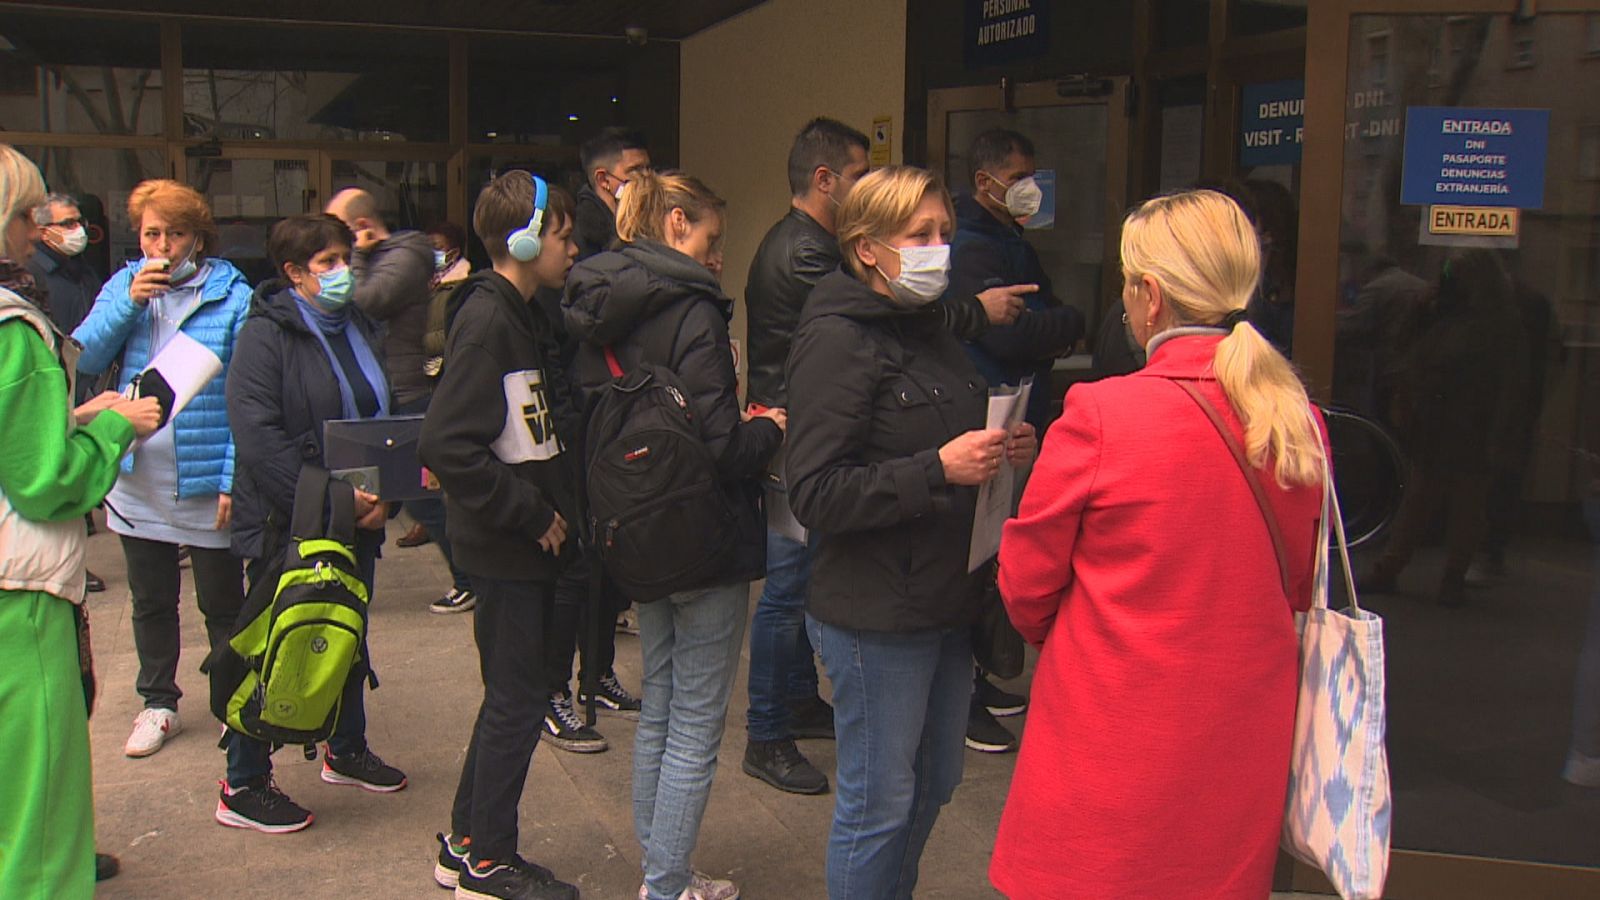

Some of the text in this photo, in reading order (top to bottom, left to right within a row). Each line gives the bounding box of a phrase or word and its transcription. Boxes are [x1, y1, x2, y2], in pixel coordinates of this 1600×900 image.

[977, 14, 1036, 46] AUTORIZADO
[1258, 98, 1304, 119] DENU
[1442, 119, 1512, 135] ENTRADA
[1244, 129, 1283, 147] VISIT
[1465, 140, 1486, 149] DNI
[1442, 154, 1507, 165] PASAPORTE
[1441, 169, 1506, 179] DENUNCIAS
[1435, 182, 1509, 194] EXTRANJERÍA
[1434, 211, 1511, 229] ENTRADA
